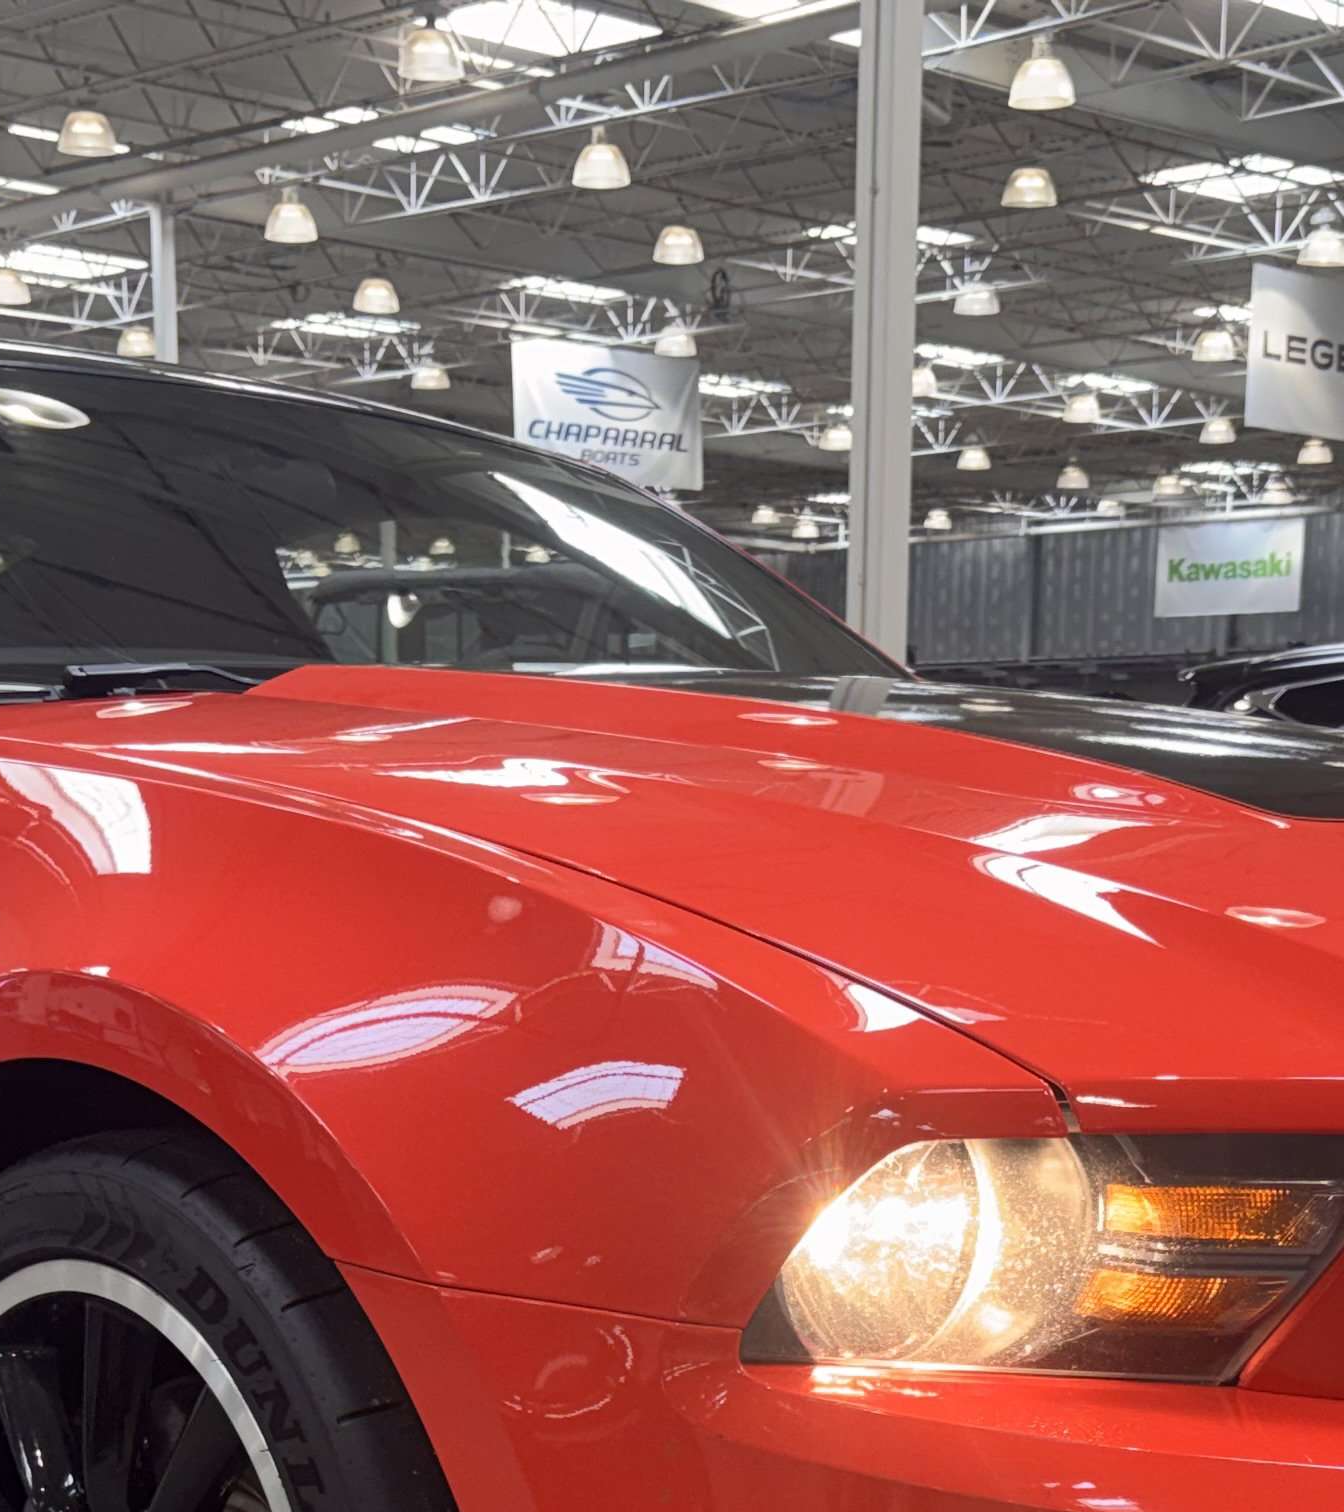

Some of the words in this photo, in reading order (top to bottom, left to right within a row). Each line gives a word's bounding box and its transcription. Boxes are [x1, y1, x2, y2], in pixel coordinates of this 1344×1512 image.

[528, 419, 687, 453] CHAPARRAL
[581, 448, 640, 466] BOATS
[1167, 551, 1293, 582] Kawasaki
